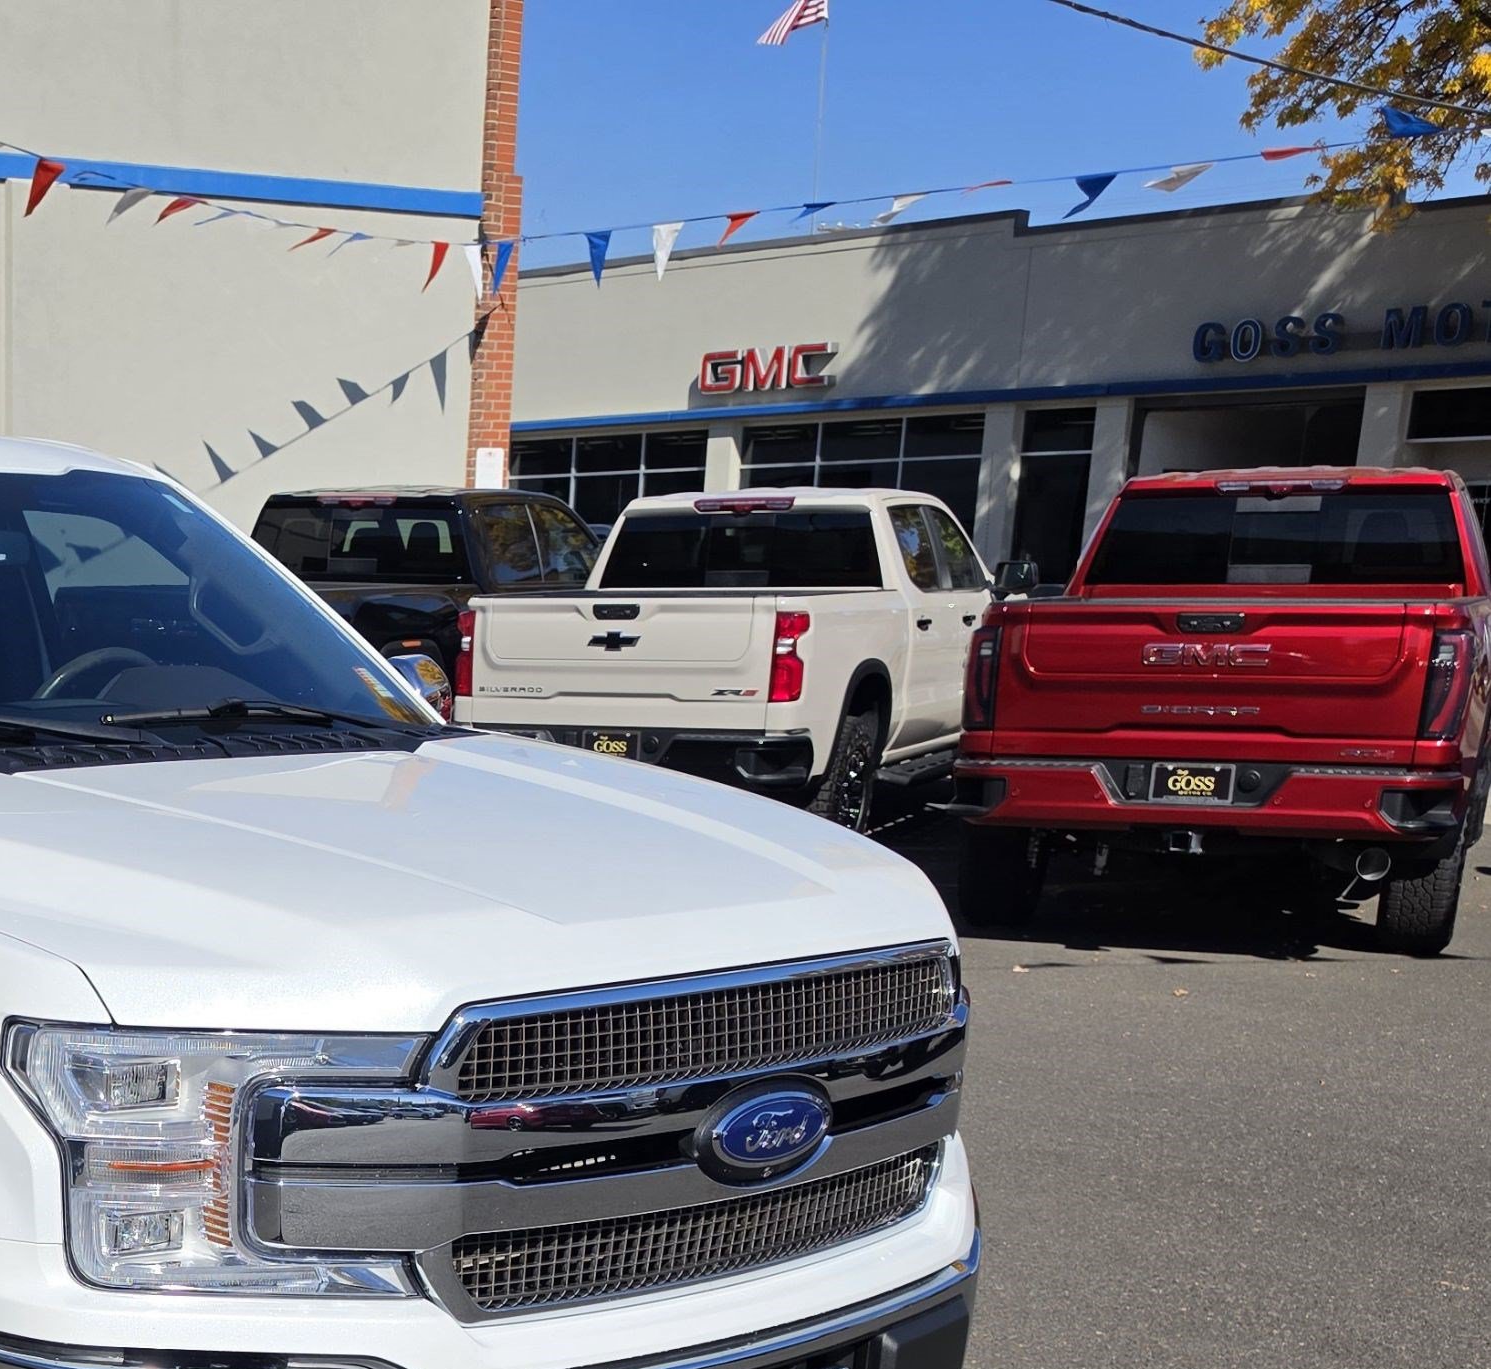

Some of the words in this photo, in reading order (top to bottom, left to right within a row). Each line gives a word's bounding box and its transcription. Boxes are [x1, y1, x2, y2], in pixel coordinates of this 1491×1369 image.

[1192, 312, 1345, 363] GOSS
[698, 342, 839, 395] GMC
[1142, 643, 1271, 666] GMC
[593, 741, 627, 753] GOSS
[1167, 775, 1215, 791] GOSS
[745, 1109, 809, 1153] Ford
